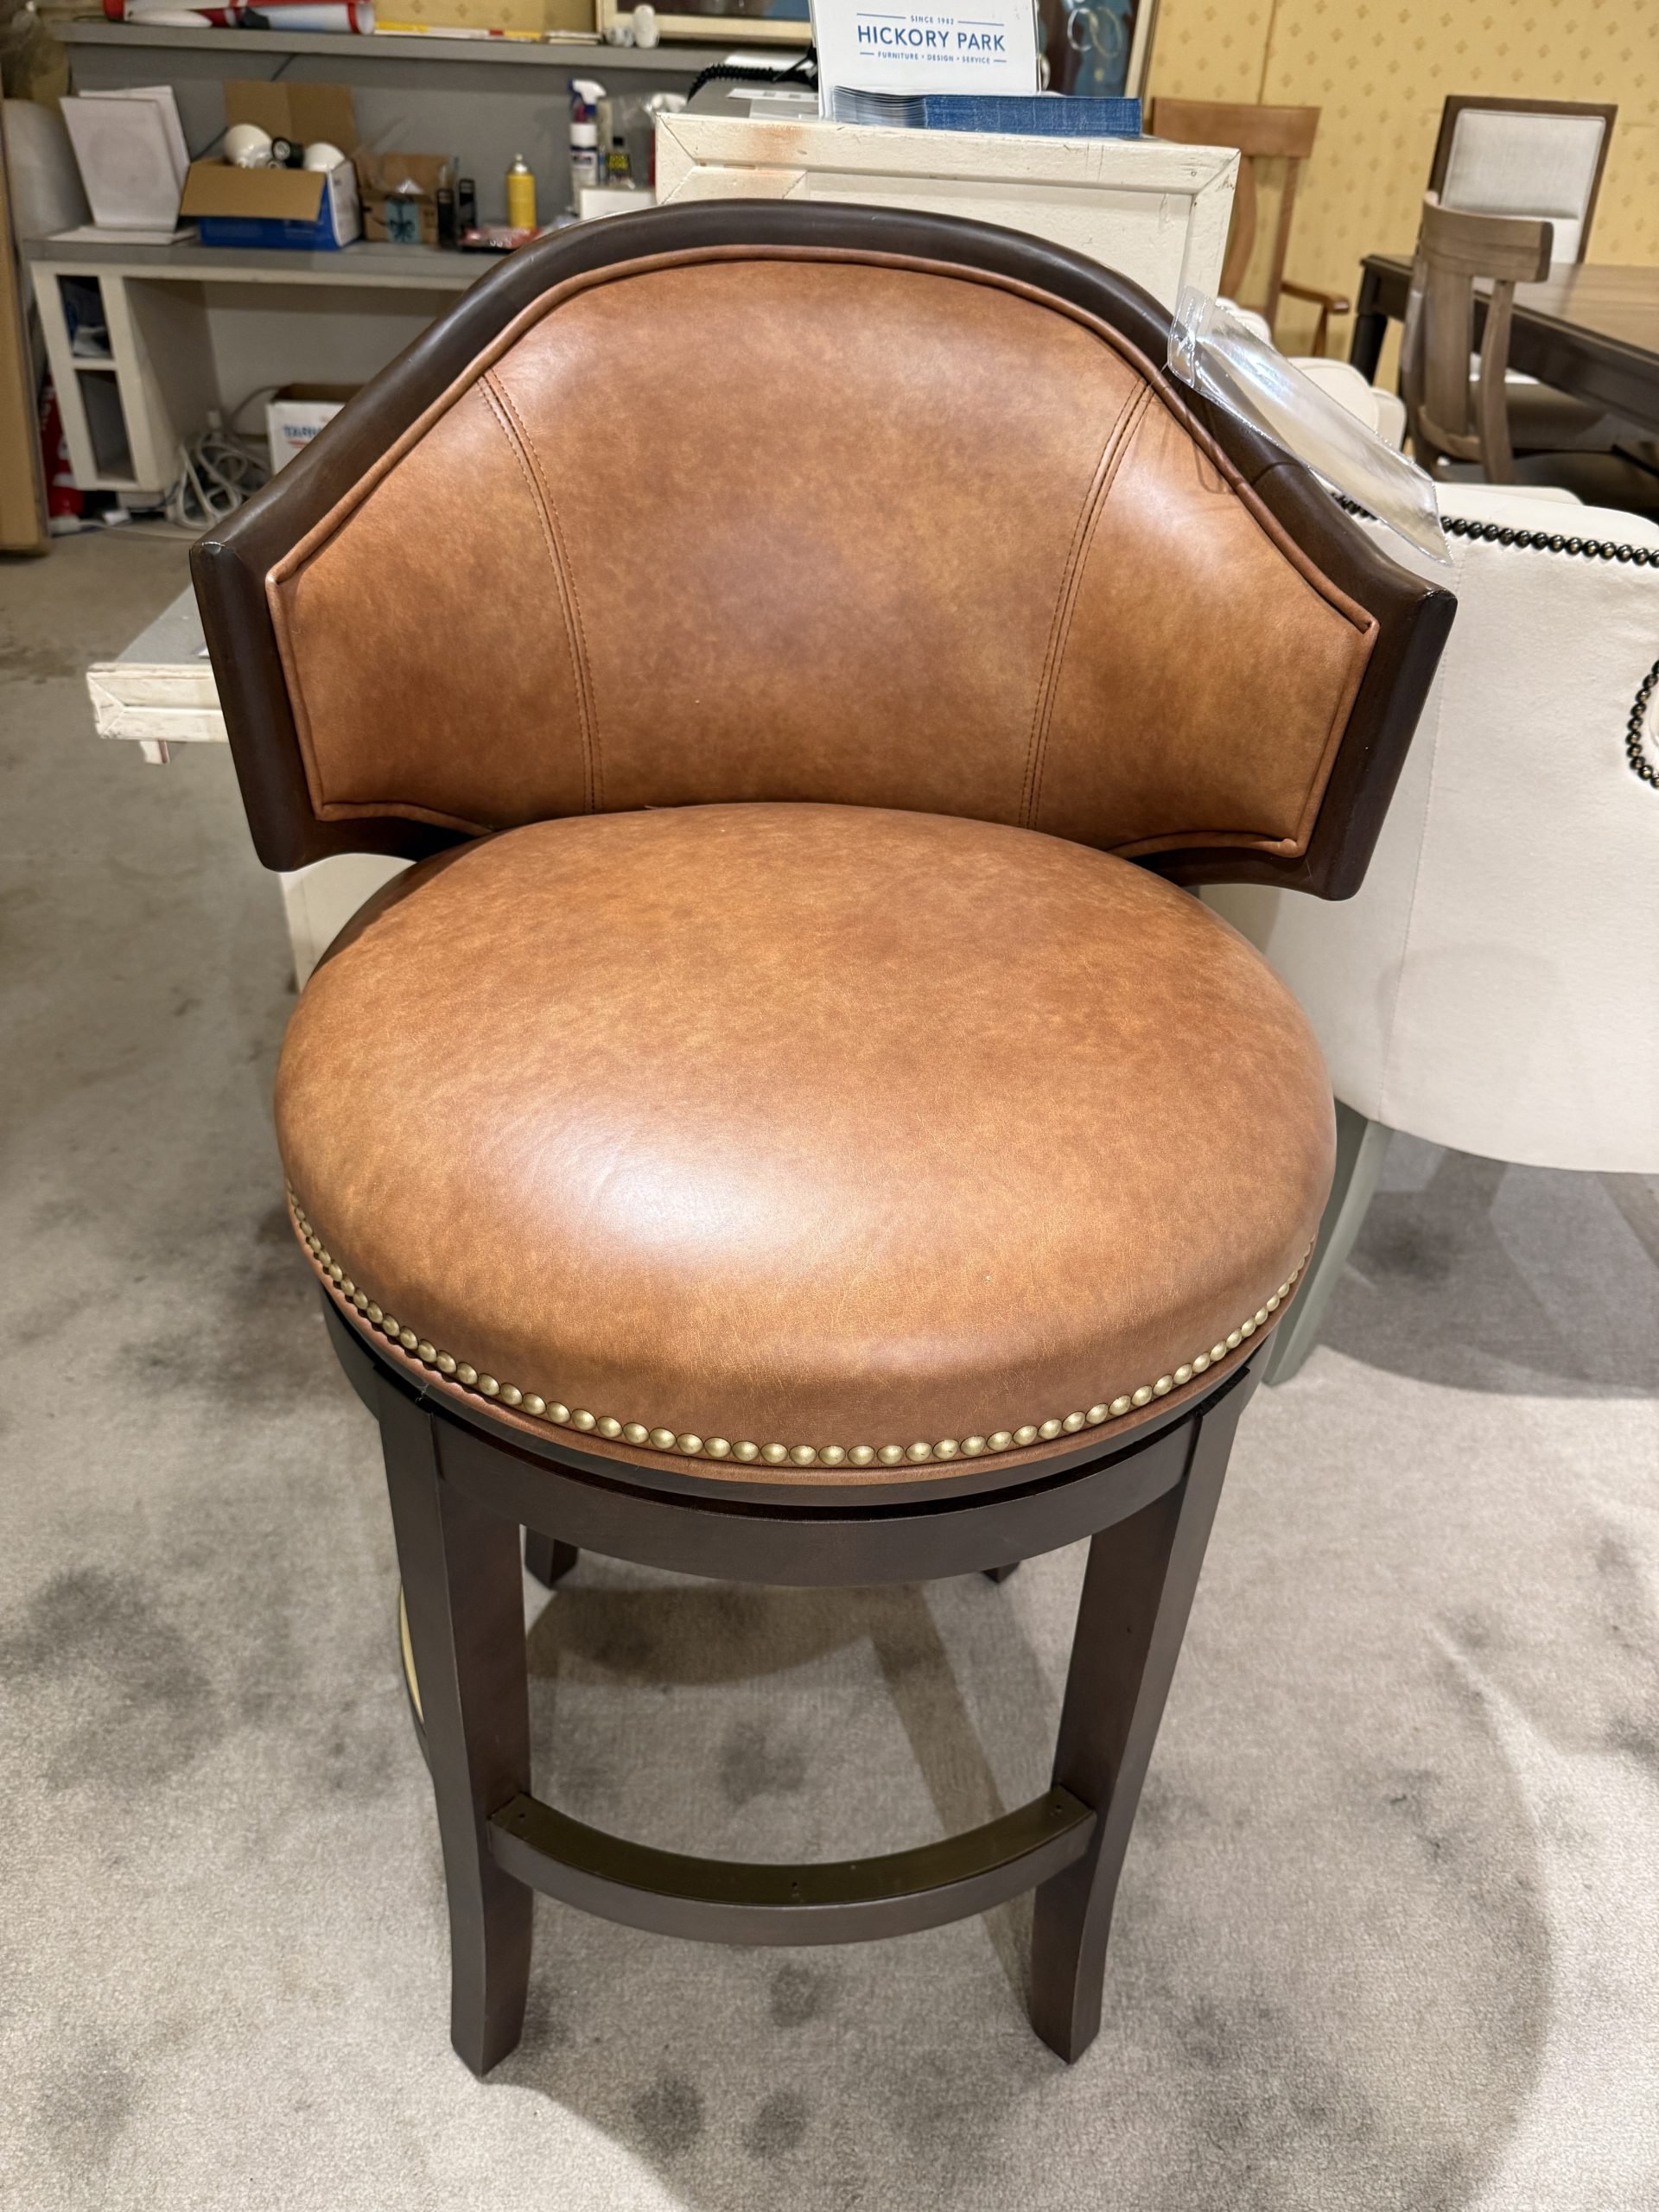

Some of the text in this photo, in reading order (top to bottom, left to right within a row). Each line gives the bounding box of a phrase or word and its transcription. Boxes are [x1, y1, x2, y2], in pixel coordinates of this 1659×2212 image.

[910, 15, 934, 23] SINCE
[857, 25, 1006, 52] HICKORY PARK
[877, 51, 991, 64] FURNITURE DESIGN SERVICE
